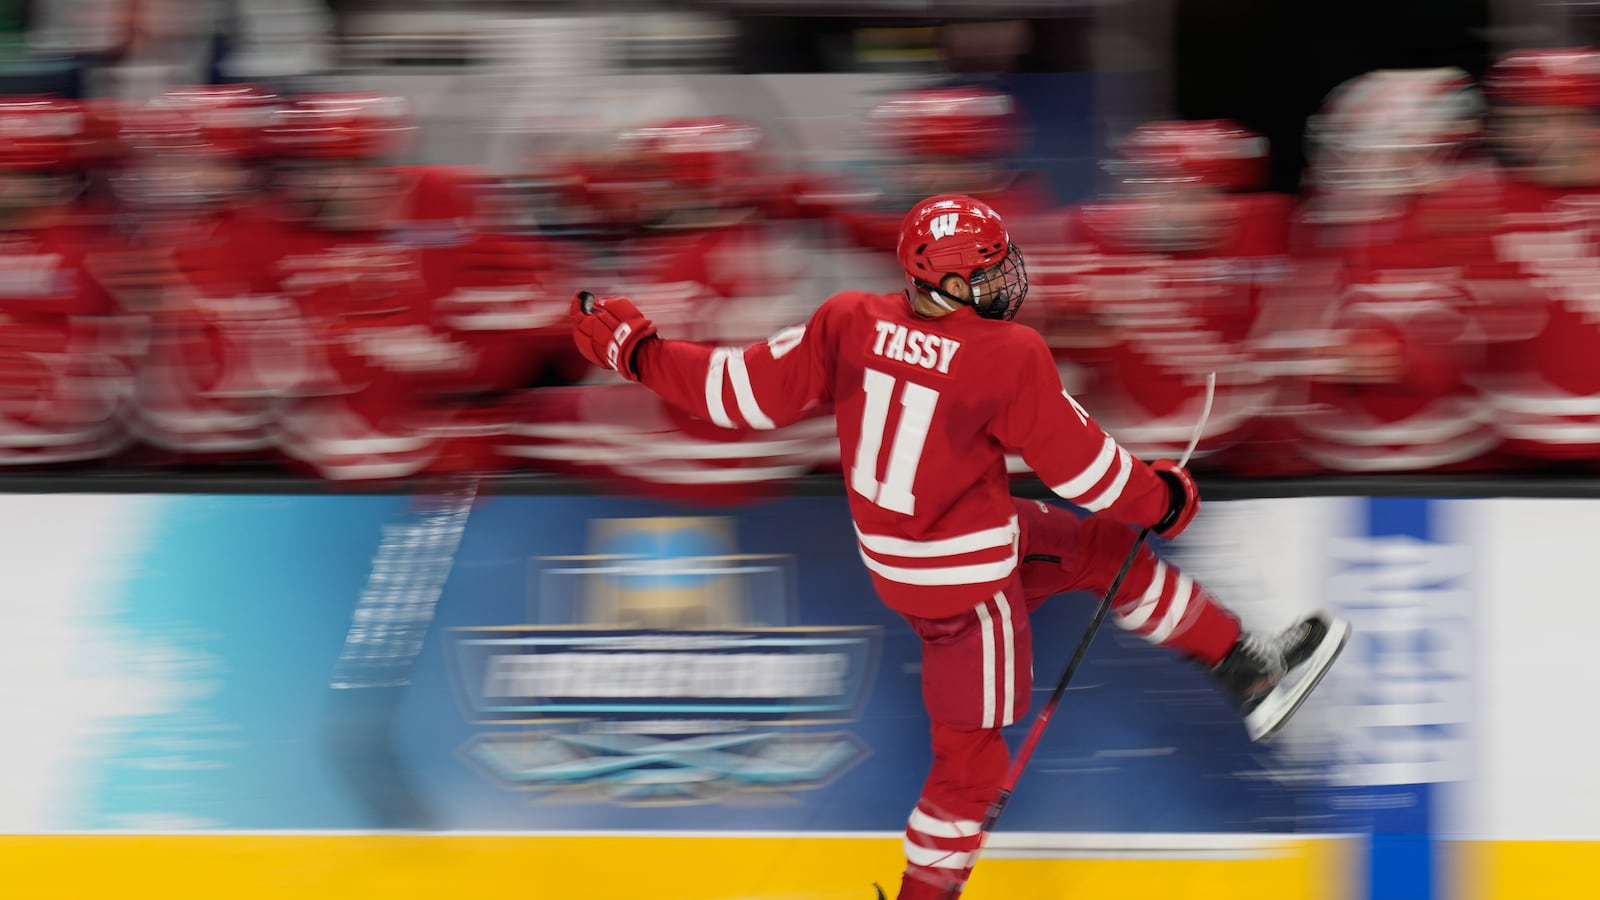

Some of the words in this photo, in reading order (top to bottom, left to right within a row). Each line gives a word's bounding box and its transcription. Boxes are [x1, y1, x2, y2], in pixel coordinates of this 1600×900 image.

[607, 322, 632, 371] CC
[872, 320, 961, 375] TASSY
[851, 367, 940, 517] 11
